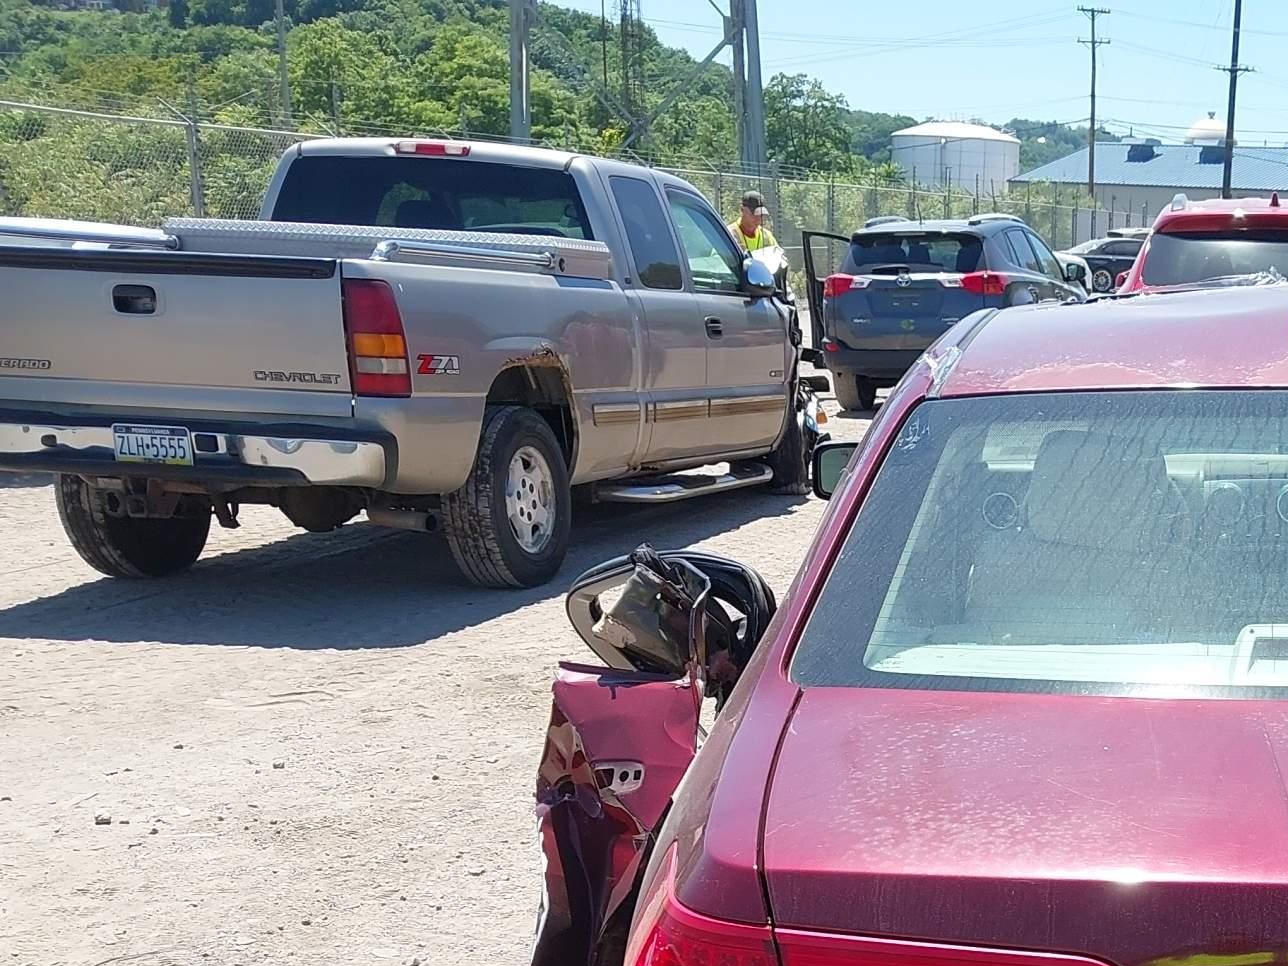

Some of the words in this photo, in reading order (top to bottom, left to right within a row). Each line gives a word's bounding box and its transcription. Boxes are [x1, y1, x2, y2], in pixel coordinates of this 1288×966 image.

[0, 358, 50, 369] ERADO
[416, 354, 459, 374] Z71
[253, 370, 341, 385] CHEVROLET
